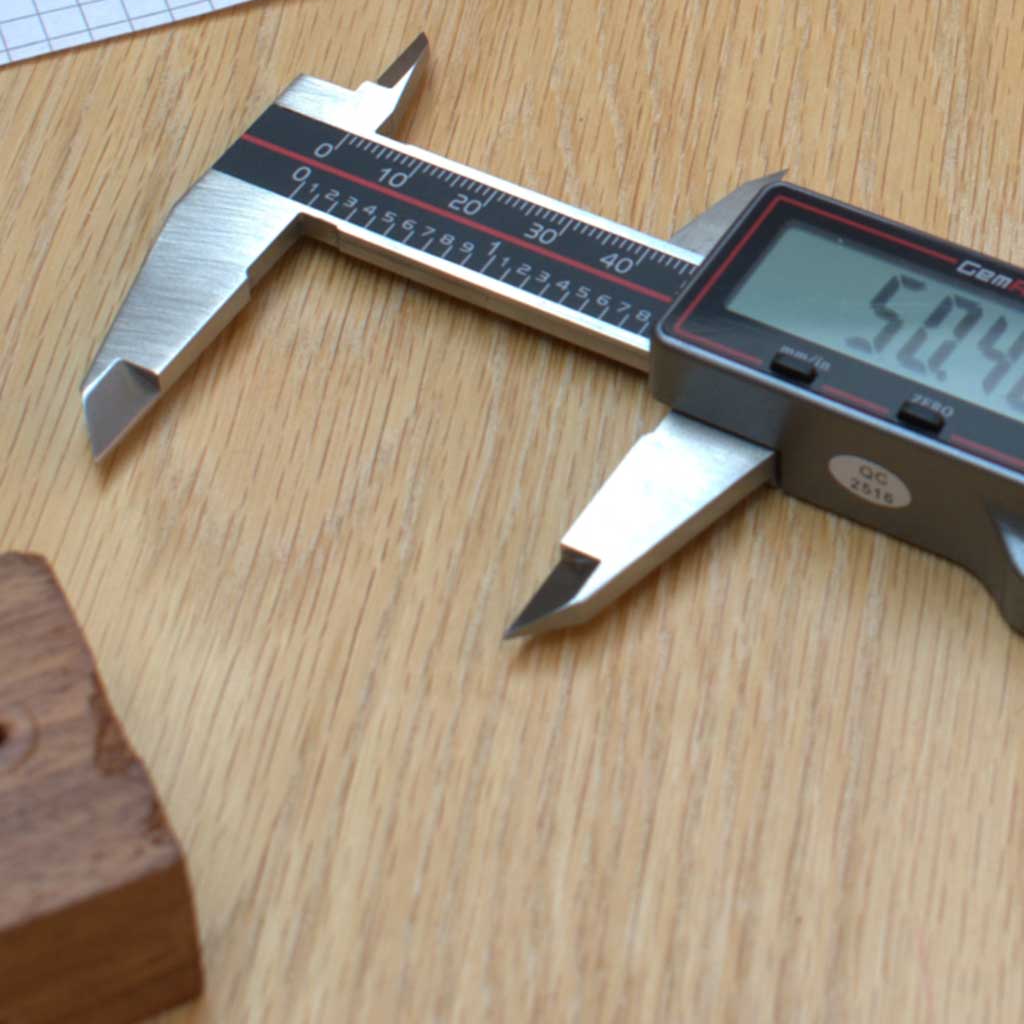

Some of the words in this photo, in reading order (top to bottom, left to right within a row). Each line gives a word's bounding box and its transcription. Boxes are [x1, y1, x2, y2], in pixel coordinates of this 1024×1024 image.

[292, 166, 312, 182] 0
[309, 183, 319, 193] 1
[324, 188, 340, 202] 2
[342, 196, 358, 208] 3
[363, 205, 378, 215] 4
[381, 211, 397, 223] 5
[401, 219, 418, 230] 6
[421, 225, 436, 237] 7
[440, 233, 455, 246] 8
[460, 241, 475, 254] 9
[487, 241, 502, 256] 1
[501, 257, 510, 267] 1
[516, 263, 532, 276] 2
[535, 270, 551, 283] 3
[555, 280, 571, 291] 4
[575, 286, 591, 298] 5
[595, 294, 612, 306] 6
[616, 302, 632, 312] 7
[635, 309, 651, 322] 8
[313, 142, 333, 158] 0
[378, 167, 409, 188] 10
[448, 193, 482, 215] 20
[523, 221, 558, 245] 30
[600, 253, 633, 274] 40
